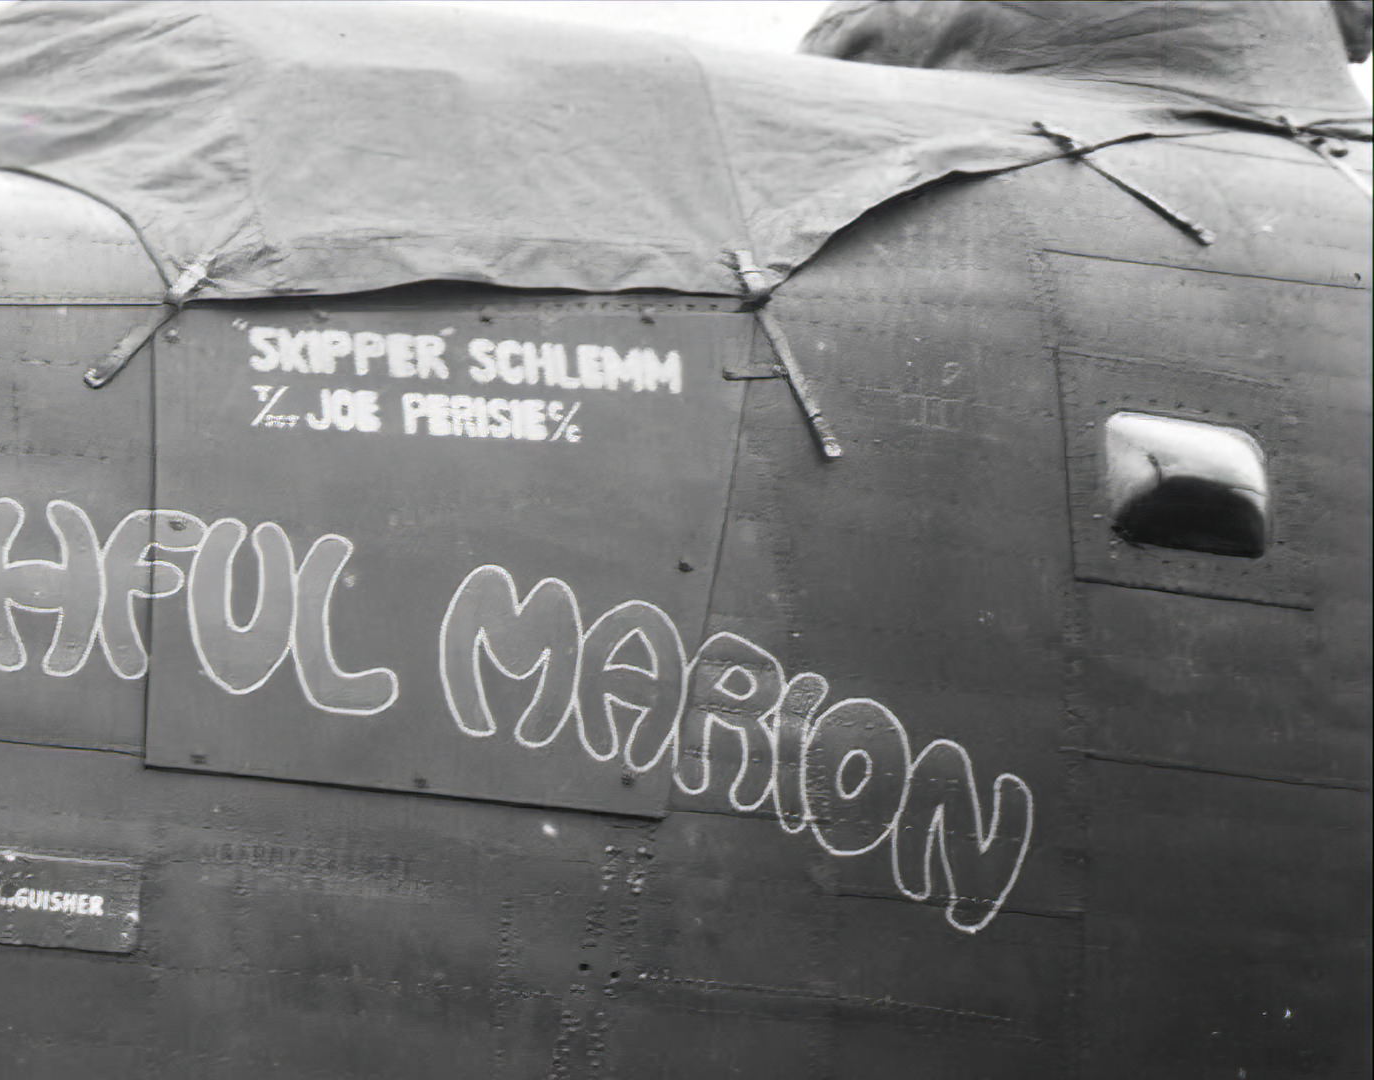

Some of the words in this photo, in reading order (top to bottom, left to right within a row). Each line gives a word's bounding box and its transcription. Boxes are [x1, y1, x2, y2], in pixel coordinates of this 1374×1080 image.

[467, 338, 684, 395] SCHLEMM
[305, 388, 383, 433] JOE
[439, 563, 1034, 934] MARION
